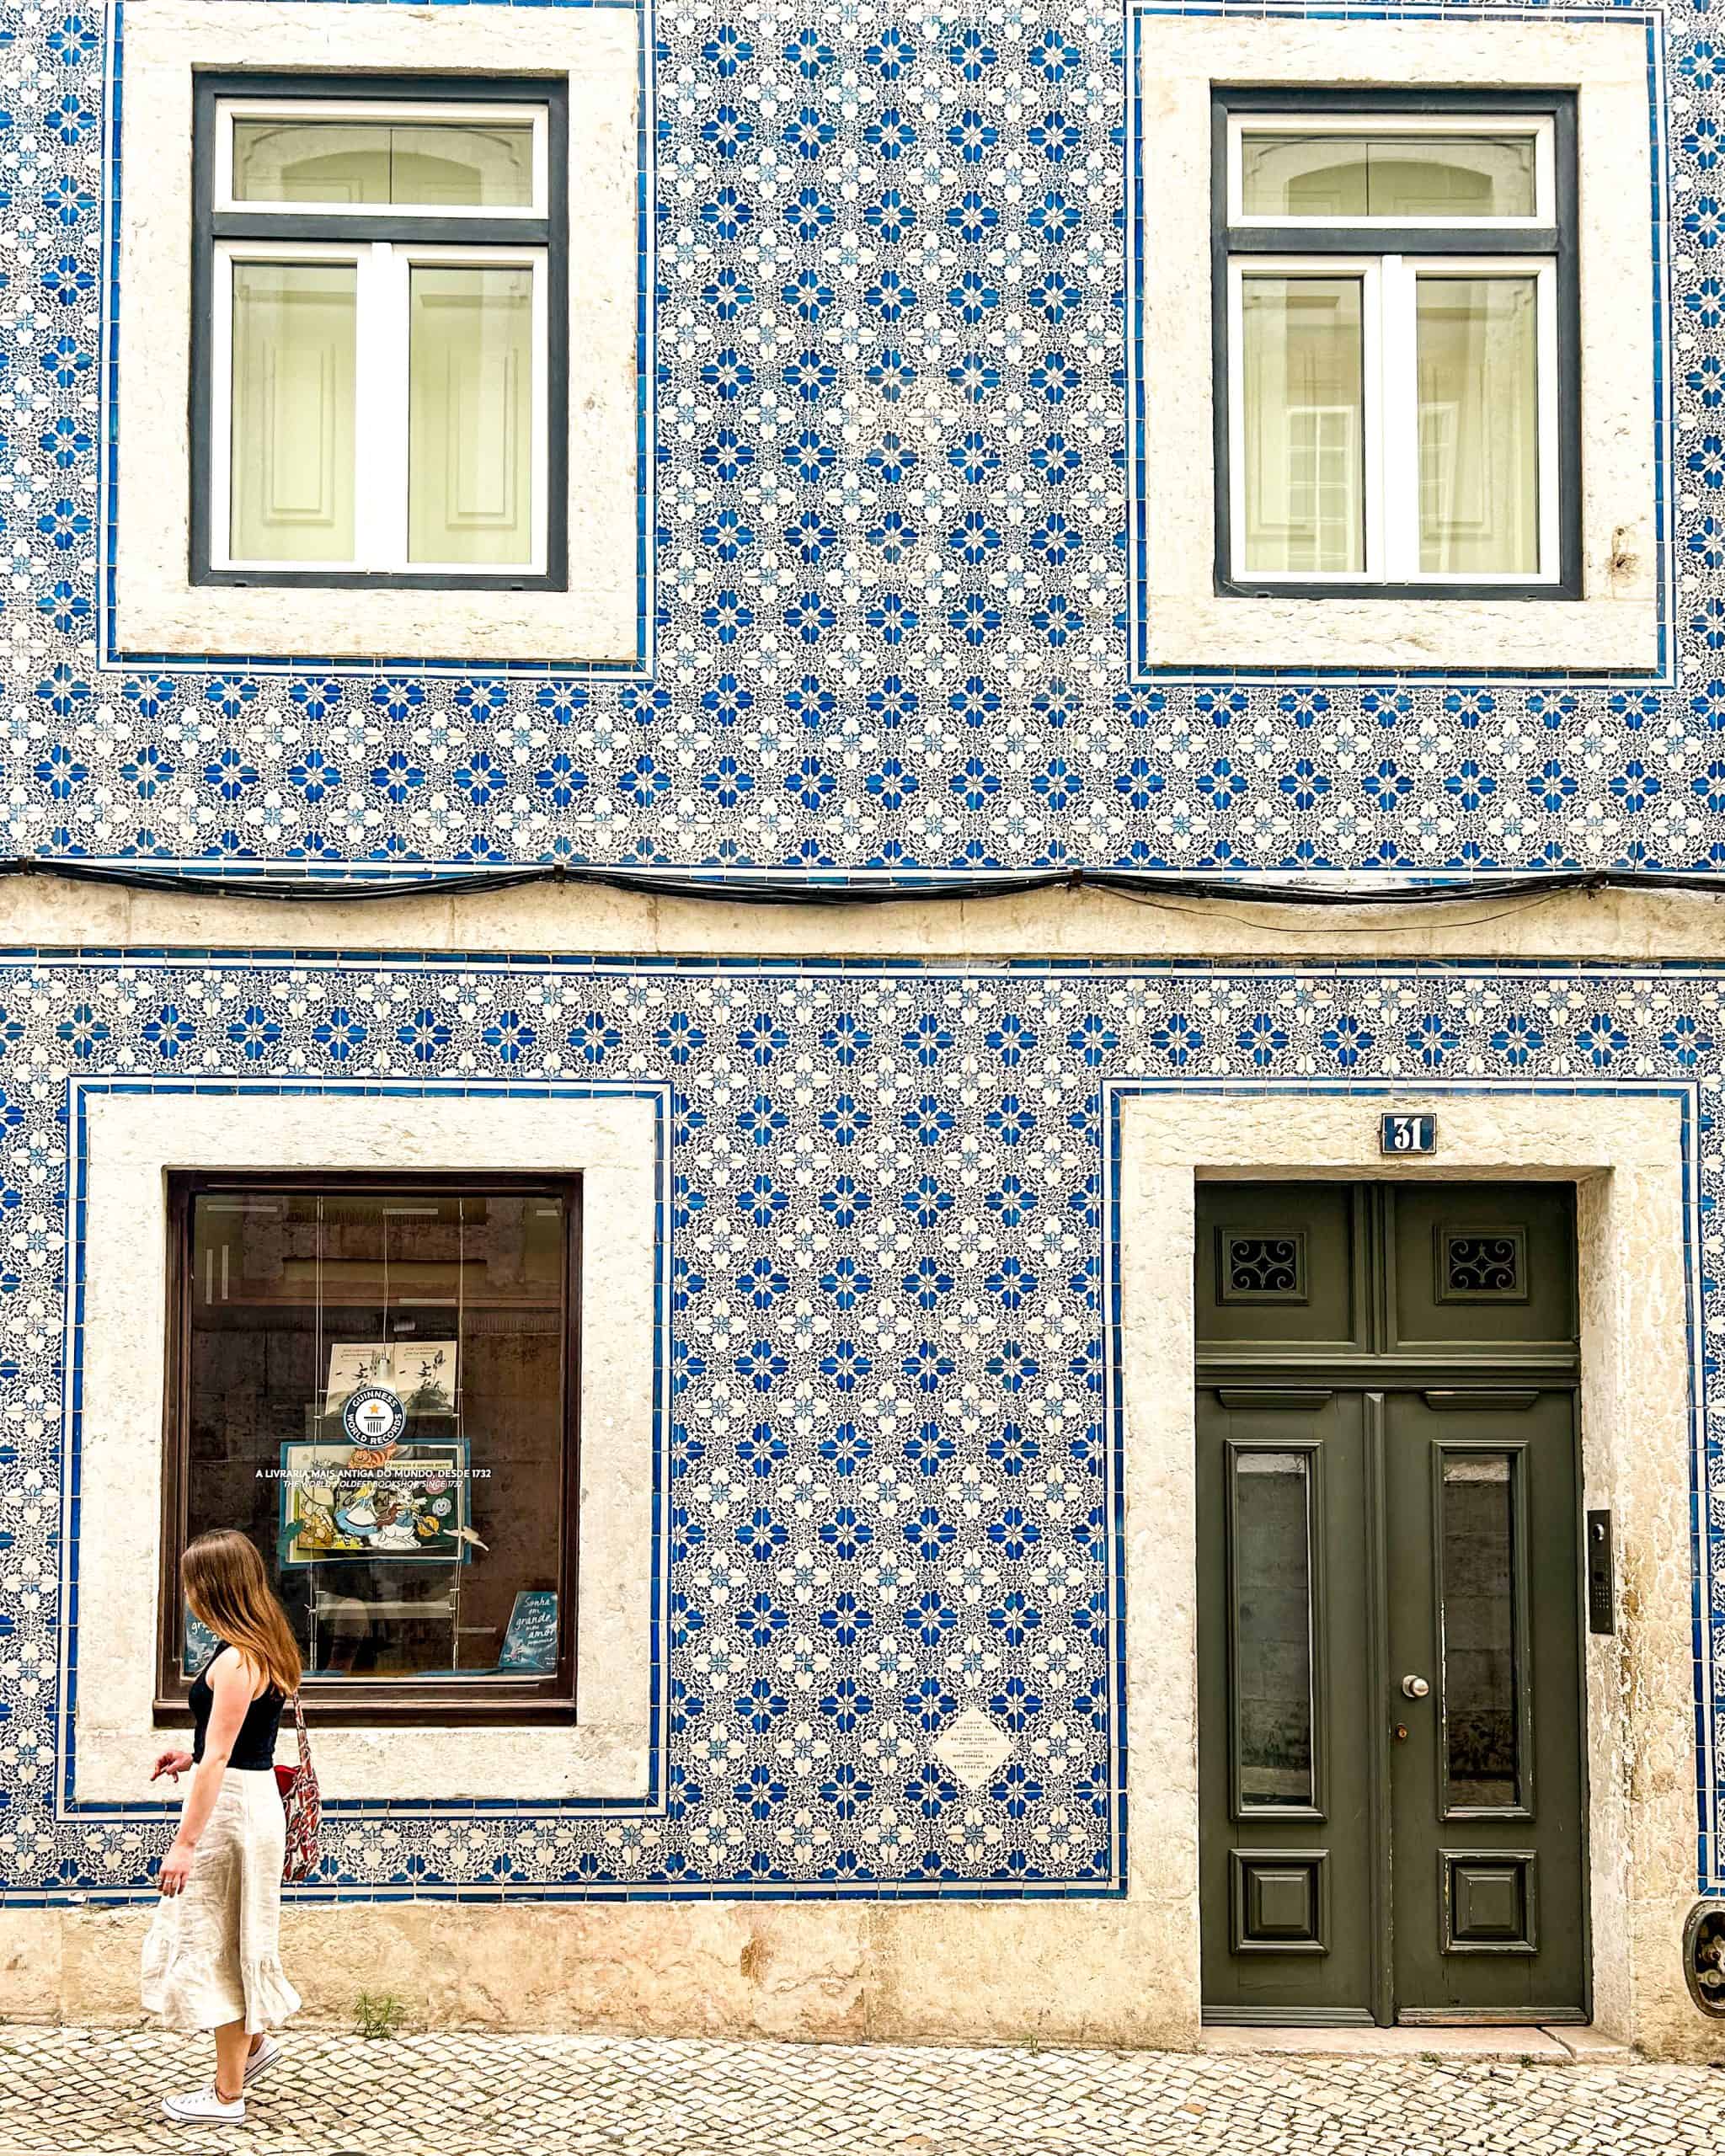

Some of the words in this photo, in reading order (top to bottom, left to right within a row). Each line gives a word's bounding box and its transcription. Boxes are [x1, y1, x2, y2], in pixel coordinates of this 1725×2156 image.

[1393, 1118, 1423, 1150] 31
[352, 1390, 398, 1407] GUINNESS
[347, 1414, 367, 1443] WORLD
[370, 1413, 402, 1444] RECORDS
[255, 1469, 263, 1478] A
[264, 1469, 308, 1478] LIVRARIA
[311, 1469, 334, 1478] MAIS
[337, 1469, 374, 1478] ANTIGA
[377, 1469, 392, 1478] DO
[393, 1469, 435, 1479] MUNDO,
[437, 1469, 470, 1478] DESDE
[472, 1469, 492, 1478] 1732
[283, 1480, 300, 1488] THE
[339, 1480, 371, 1488] OLDEST
[421, 1480, 446, 1488] SINCE
[447, 1480, 464, 1488] 1732
[525, 1597, 551, 1607] Sonha
[527, 1629, 553, 1638] amor
